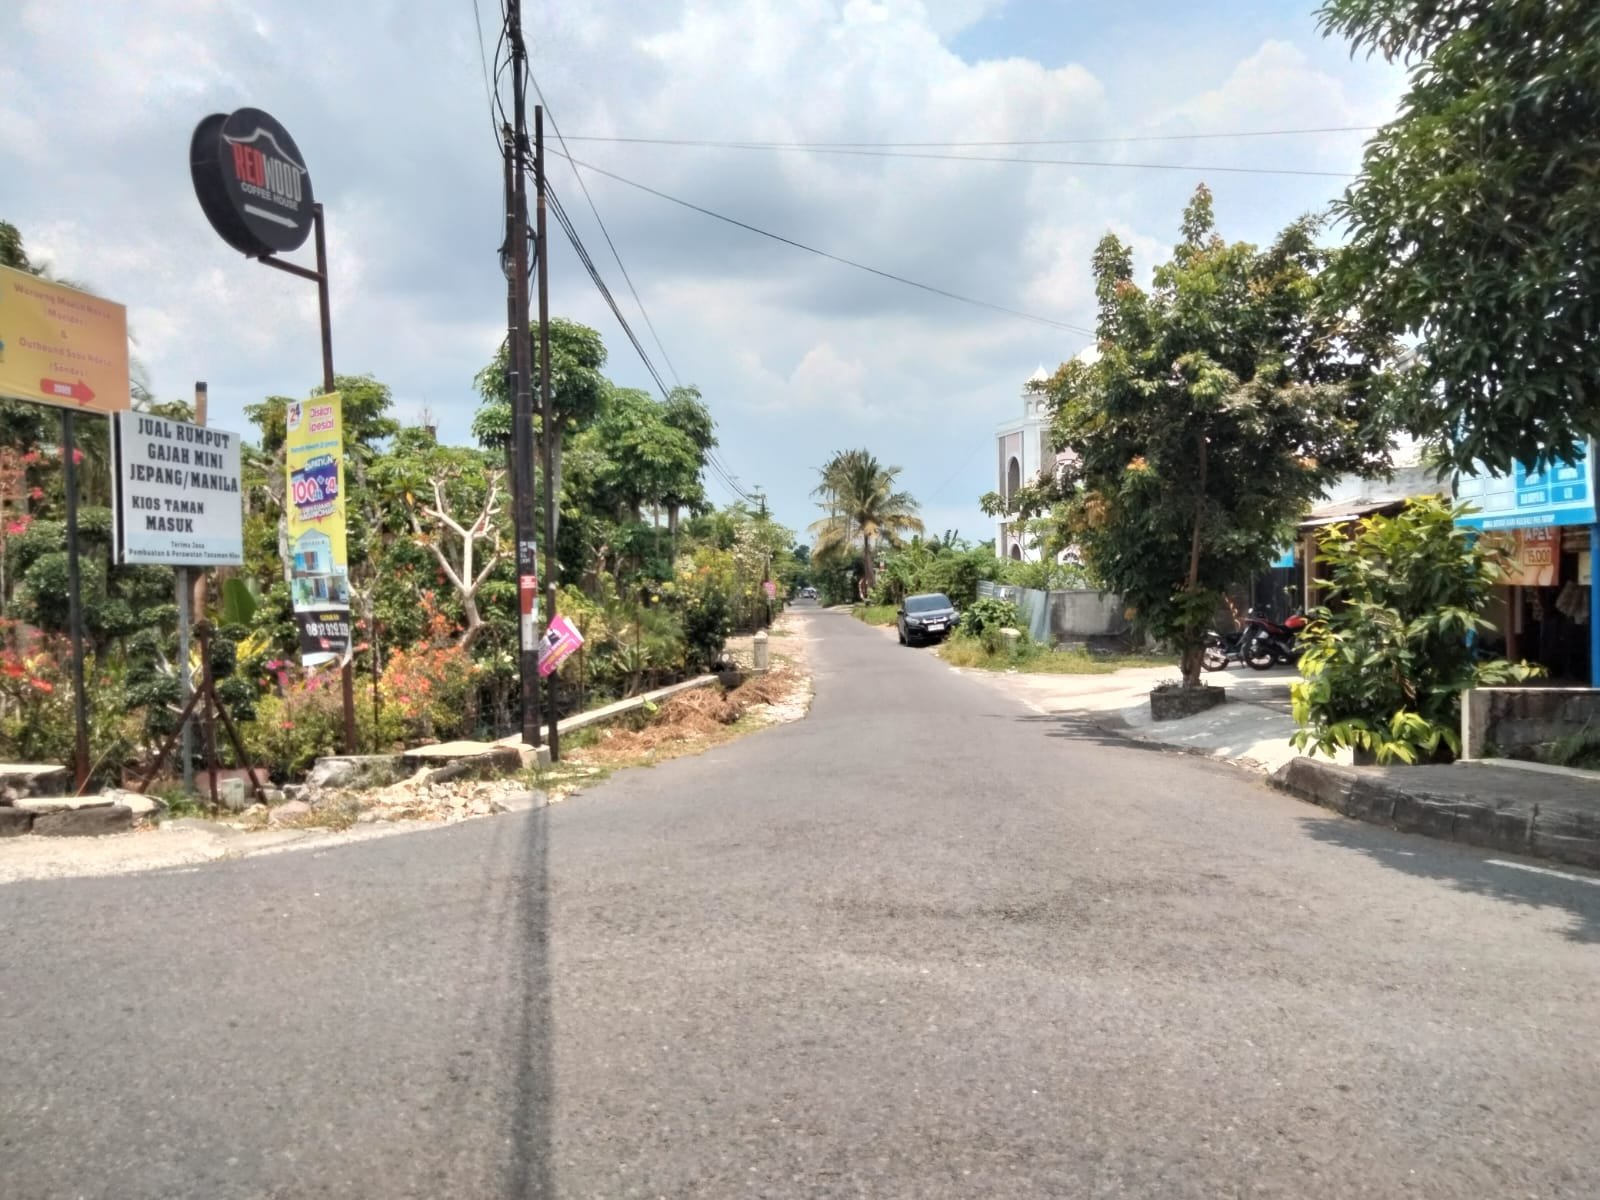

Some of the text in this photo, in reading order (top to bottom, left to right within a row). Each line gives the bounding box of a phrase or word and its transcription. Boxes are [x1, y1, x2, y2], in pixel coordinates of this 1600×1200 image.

[232, 142, 302, 202] REDWOOD
[240, 181, 298, 211] COFFEE HOUSE
[138, 418, 230, 449] JUAL RUMPUT
[148, 442, 223, 470] GAJAH MINI
[130, 463, 239, 492] JEPANG/MANILA
[132, 495, 205, 515] KIOS TAMAN
[145, 515, 194, 533] MASUK
